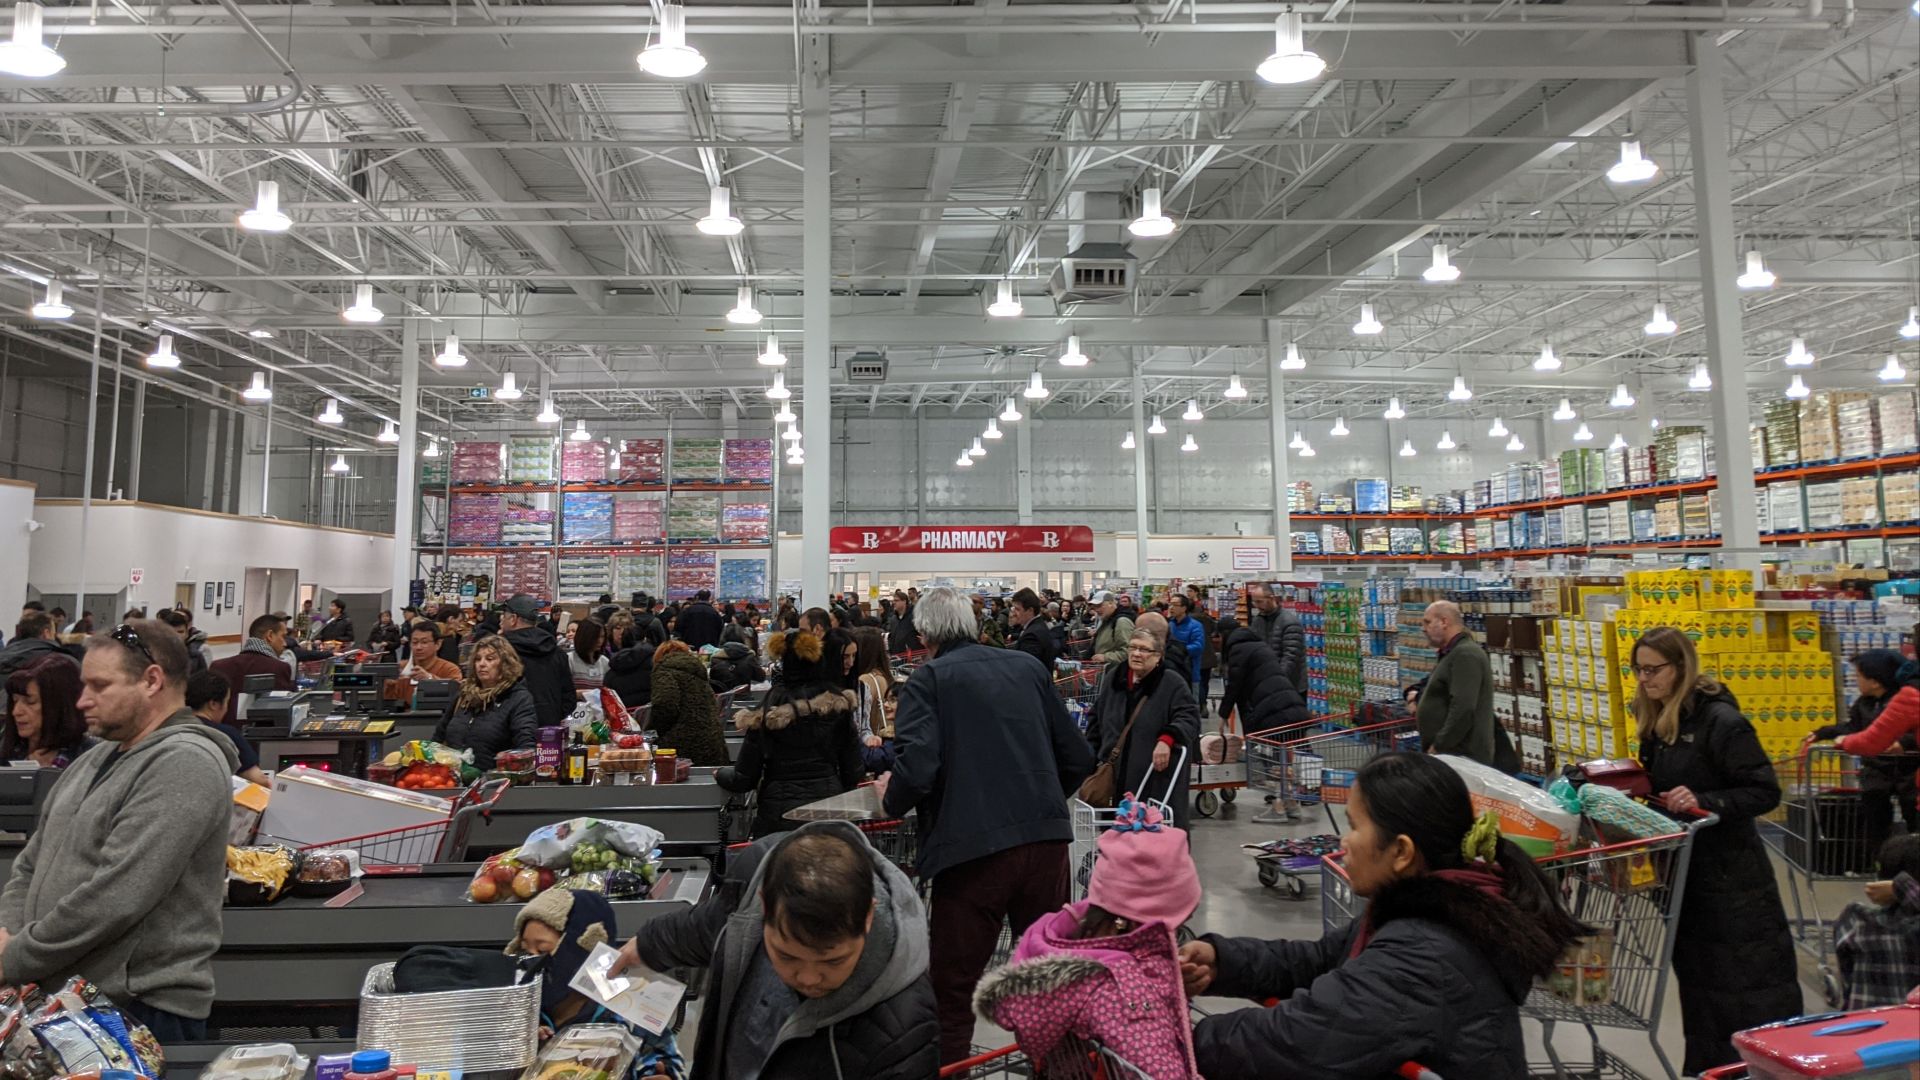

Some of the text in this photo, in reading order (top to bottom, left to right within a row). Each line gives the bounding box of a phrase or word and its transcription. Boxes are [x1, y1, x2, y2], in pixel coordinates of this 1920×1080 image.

[921, 531, 1007, 549] PHARMACY
[536, 747, 559, 756] Raisin
[538, 755, 557, 764] Bran
